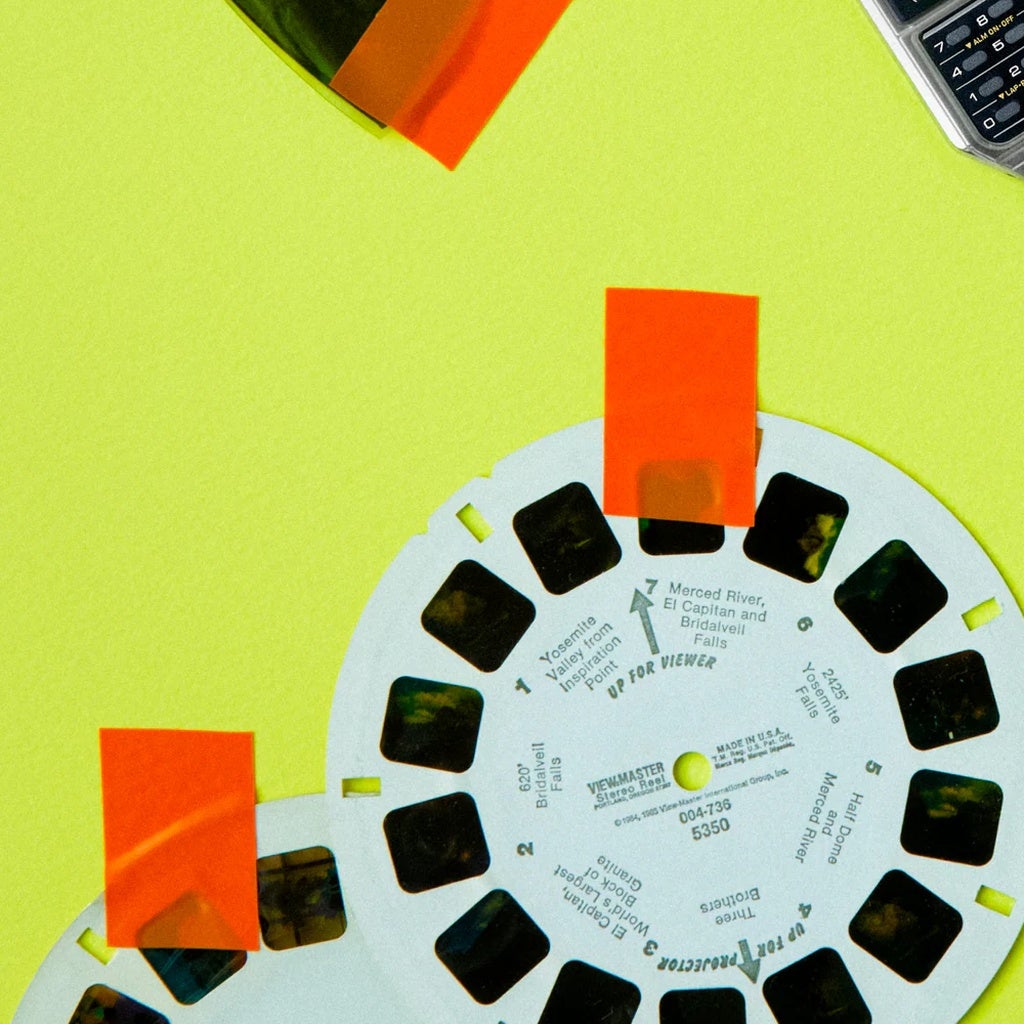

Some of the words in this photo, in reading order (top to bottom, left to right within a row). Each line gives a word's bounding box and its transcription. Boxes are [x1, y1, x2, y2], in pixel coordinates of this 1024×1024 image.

[976, 14, 989, 27] 8
[933, 41, 944, 53] 7
[973, 33, 988, 46] ALM
[992, 39, 1005, 52] 5
[952, 66, 963, 78] 4
[1008, 65, 1022, 78] 2
[969, 92, 978, 102] 1
[983, 117, 996, 130] 0
[645, 578, 658, 595] 7
[669, 581, 722, 601] Merced
[726, 590, 766, 608] River,
[664, 597, 677, 611] El
[682, 600, 735, 619] Capitan
[741, 610, 767, 622] and
[680, 616, 746, 636] Bridalveil
[797, 616, 813, 632] 6
[539, 616, 597, 665] Yosemite
[545, 648, 585, 681] Valley
[583, 622, 614, 649] from
[694, 633, 728, 649] Falls
[559, 636, 622, 693] Inspiration
[584, 660, 619, 691] Point
[607, 678, 625, 699] UP
[628, 661, 655, 684] FOR
[661, 653, 717, 670] VIEWER
[515, 677, 532, 694] 1
[802, 661, 840, 724] Yosemite
[821, 668, 849, 700] 2425'
[795, 685, 819, 719] Falls
[716, 739, 743, 754] MADE
[745, 735, 756, 745] IN
[517, 763, 531, 792] 620'
[532, 742, 548, 809] Bridalveil
[550, 757, 563, 792] Falls
[865, 759, 883, 776] 5
[596, 786, 635, 803] Stereo
[639, 774, 666, 790] Reel
[704, 780, 749, 798] International
[749, 773, 774, 785] Group,
[809, 772, 838, 825] Merced
[844, 792, 864, 823] Half
[679, 798, 732, 825] 004-736
[821, 810, 838, 837] and
[691, 817, 731, 842] 5350
[517, 842, 534, 856] 2
[795, 827, 817, 864] River
[828, 825, 852, 865] Dome
[553, 864, 601, 903] Largest
[583, 867, 599, 880] of
[597, 856, 642, 892] Granite
[600, 877, 637, 908] Block
[699, 887, 760, 914] Brothers
[562, 886, 610, 928] Capitan,
[603, 898, 650, 937] World's
[715, 906, 756, 925] Three
[798, 903, 812, 919] 4
[611, 923, 628, 940] El
[788, 922, 805, 942] UP
[643, 940, 658, 956] 3
[757, 935, 784, 958] FOR
[657, 952, 738, 974] PROJECTOR
